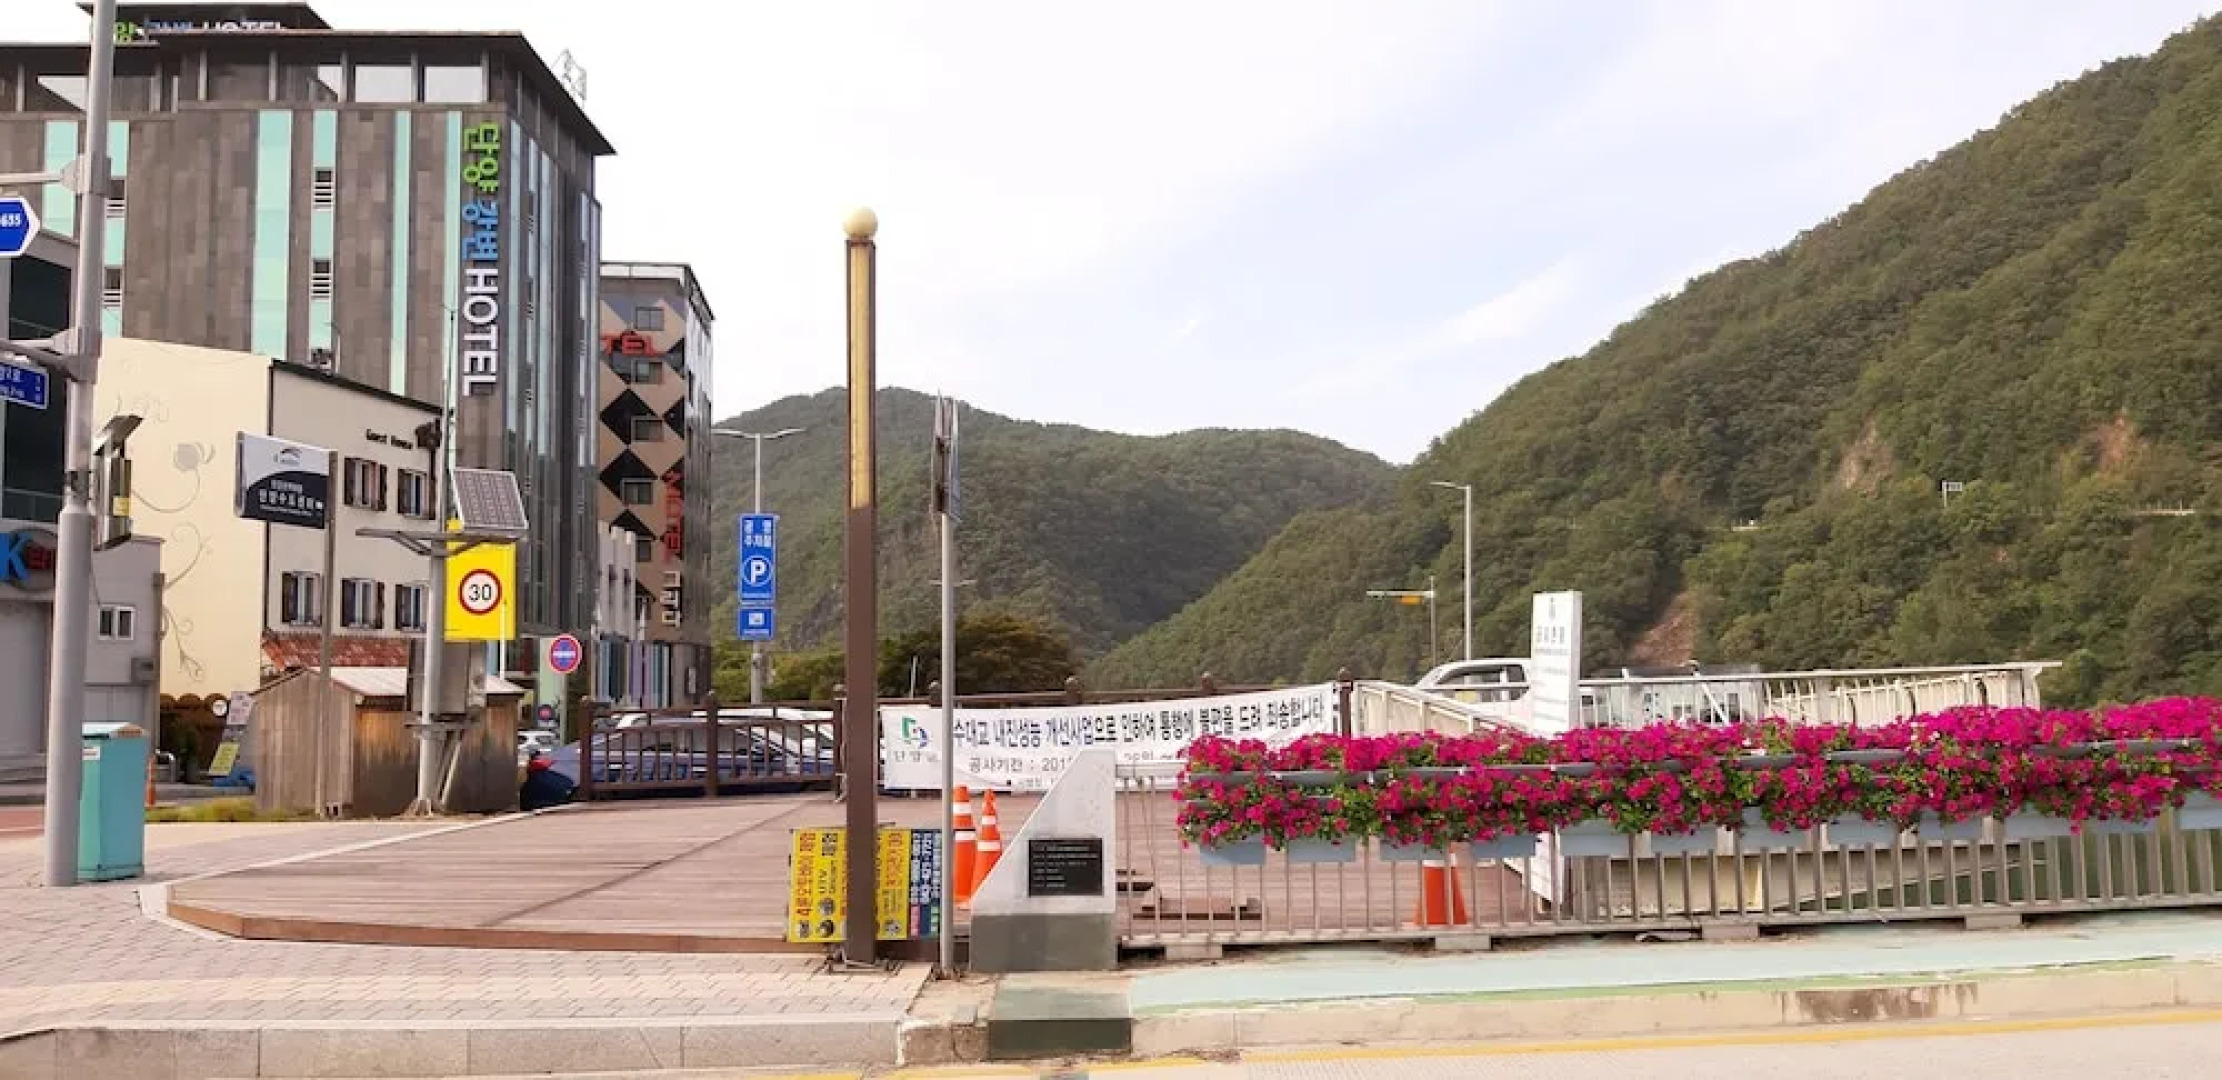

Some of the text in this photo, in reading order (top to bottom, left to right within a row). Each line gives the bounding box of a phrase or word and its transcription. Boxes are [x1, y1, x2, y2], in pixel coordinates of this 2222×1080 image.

[462, 123, 499, 396] 단양 강변 HOTEL
[750, 559, 767, 586] P
[468, 583, 493, 602] 30
[994, 717, 1041, 748] 내진성능
[1046, 714, 1118, 747] 개선사업으로
[1121, 711, 1156, 743] 인하여
[1160, 708, 1194, 742] 통행에
[1199, 704, 1234, 737] 불편을
[1239, 701, 1263, 732] 드려
[1267, 692, 1324, 730] 죄송합니다
[969, 757, 1023, 773] 공사기간
